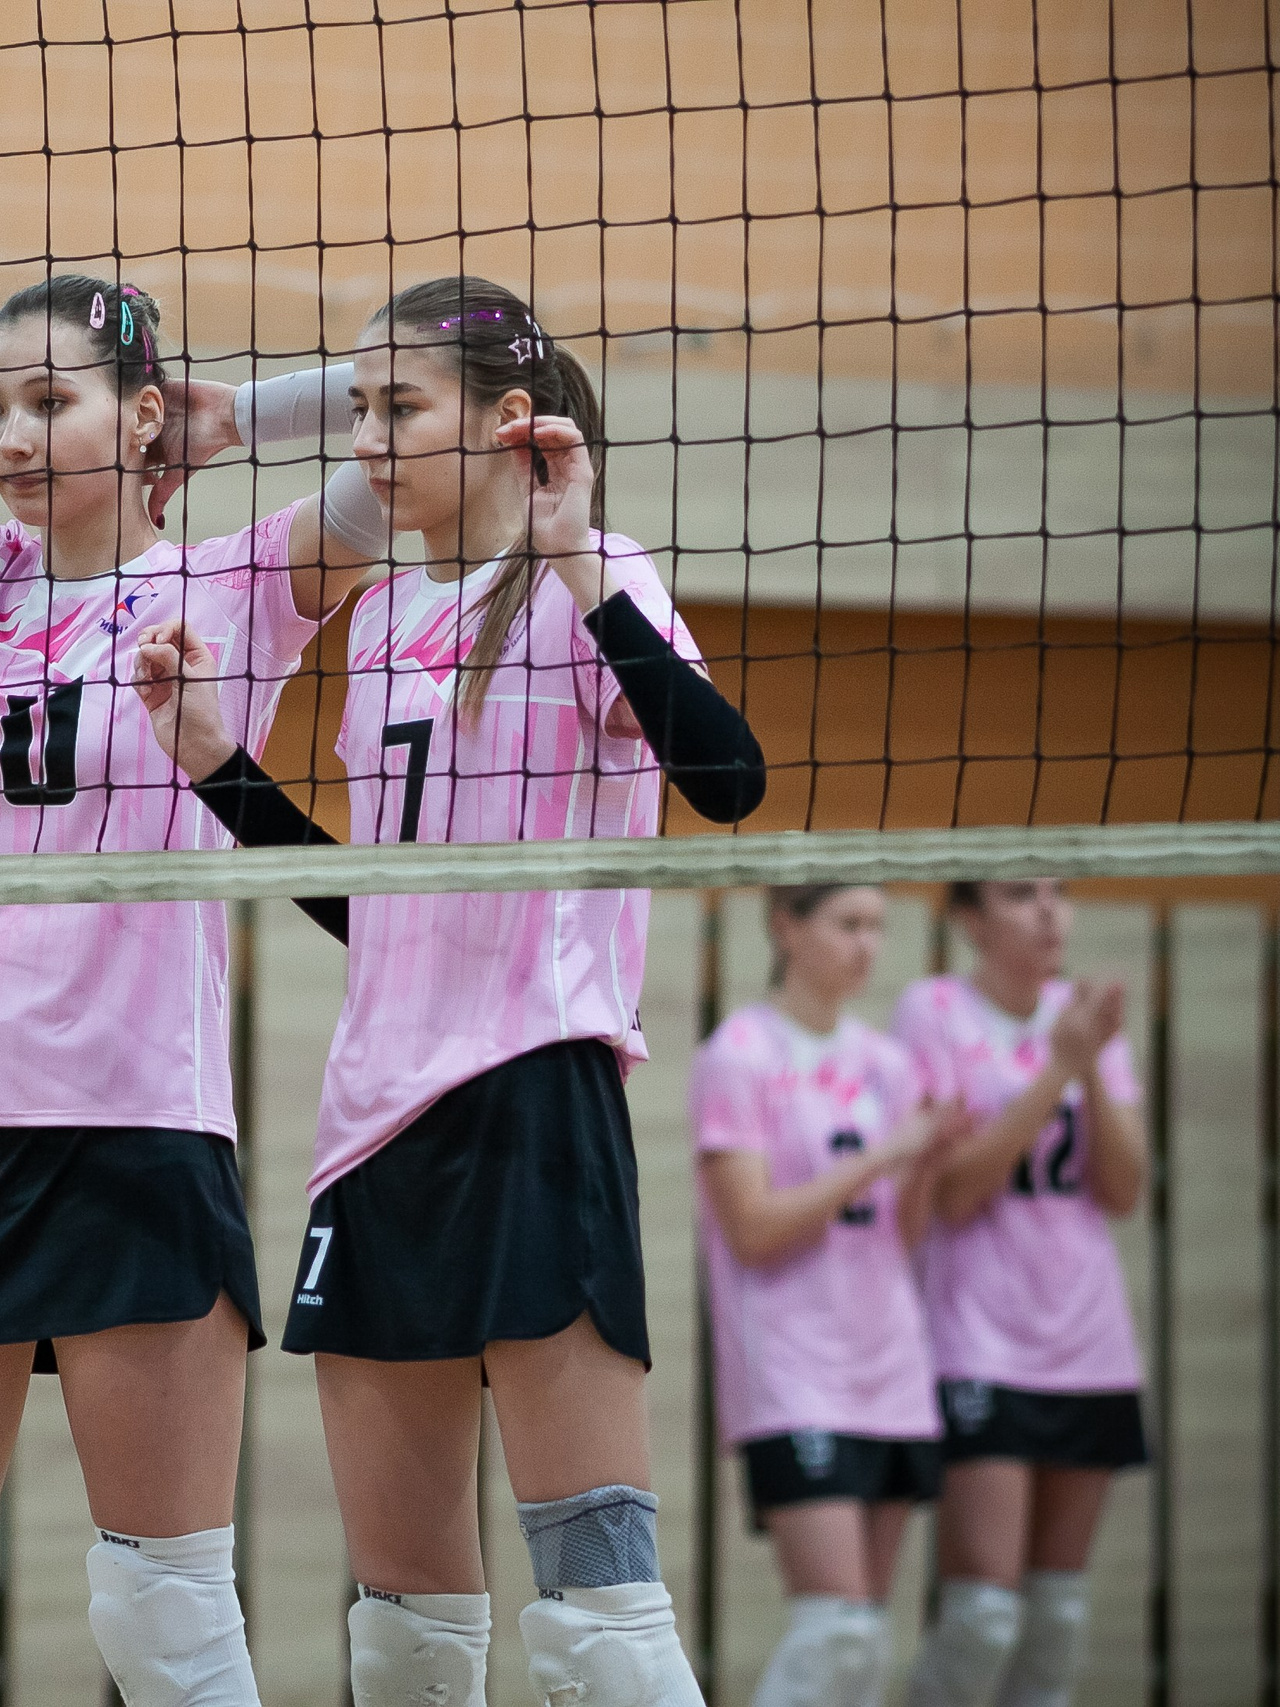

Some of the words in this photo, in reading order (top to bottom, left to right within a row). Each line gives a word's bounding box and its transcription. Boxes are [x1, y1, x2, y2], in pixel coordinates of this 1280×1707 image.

[381, 717, 435, 843] 7
[303, 1227, 334, 1290] 7
[296, 1293, 324, 1306] Hitch
